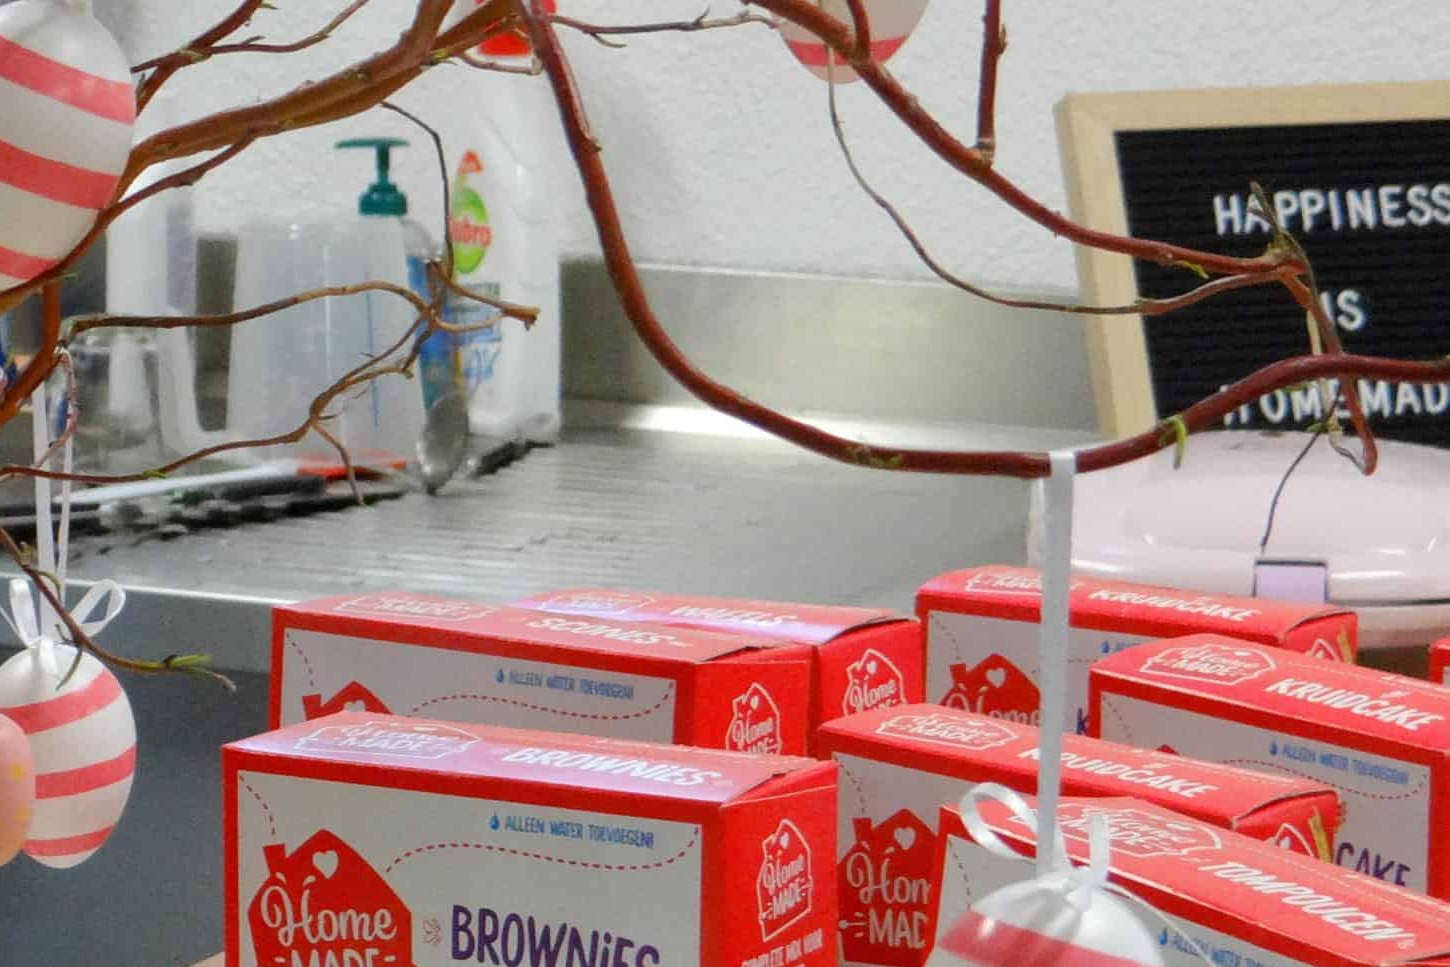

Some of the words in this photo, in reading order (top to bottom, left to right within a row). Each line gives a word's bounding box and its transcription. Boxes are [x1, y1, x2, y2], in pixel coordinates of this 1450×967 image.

[1214, 184, 1450, 237] HAPPINESS
[1264, 677, 1445, 731] KRUIDCAKE
[504, 815, 545, 835] ALLEEN
[260, 885, 398, 947] Home
[1198, 861, 1415, 941] TOMPOUCEN
